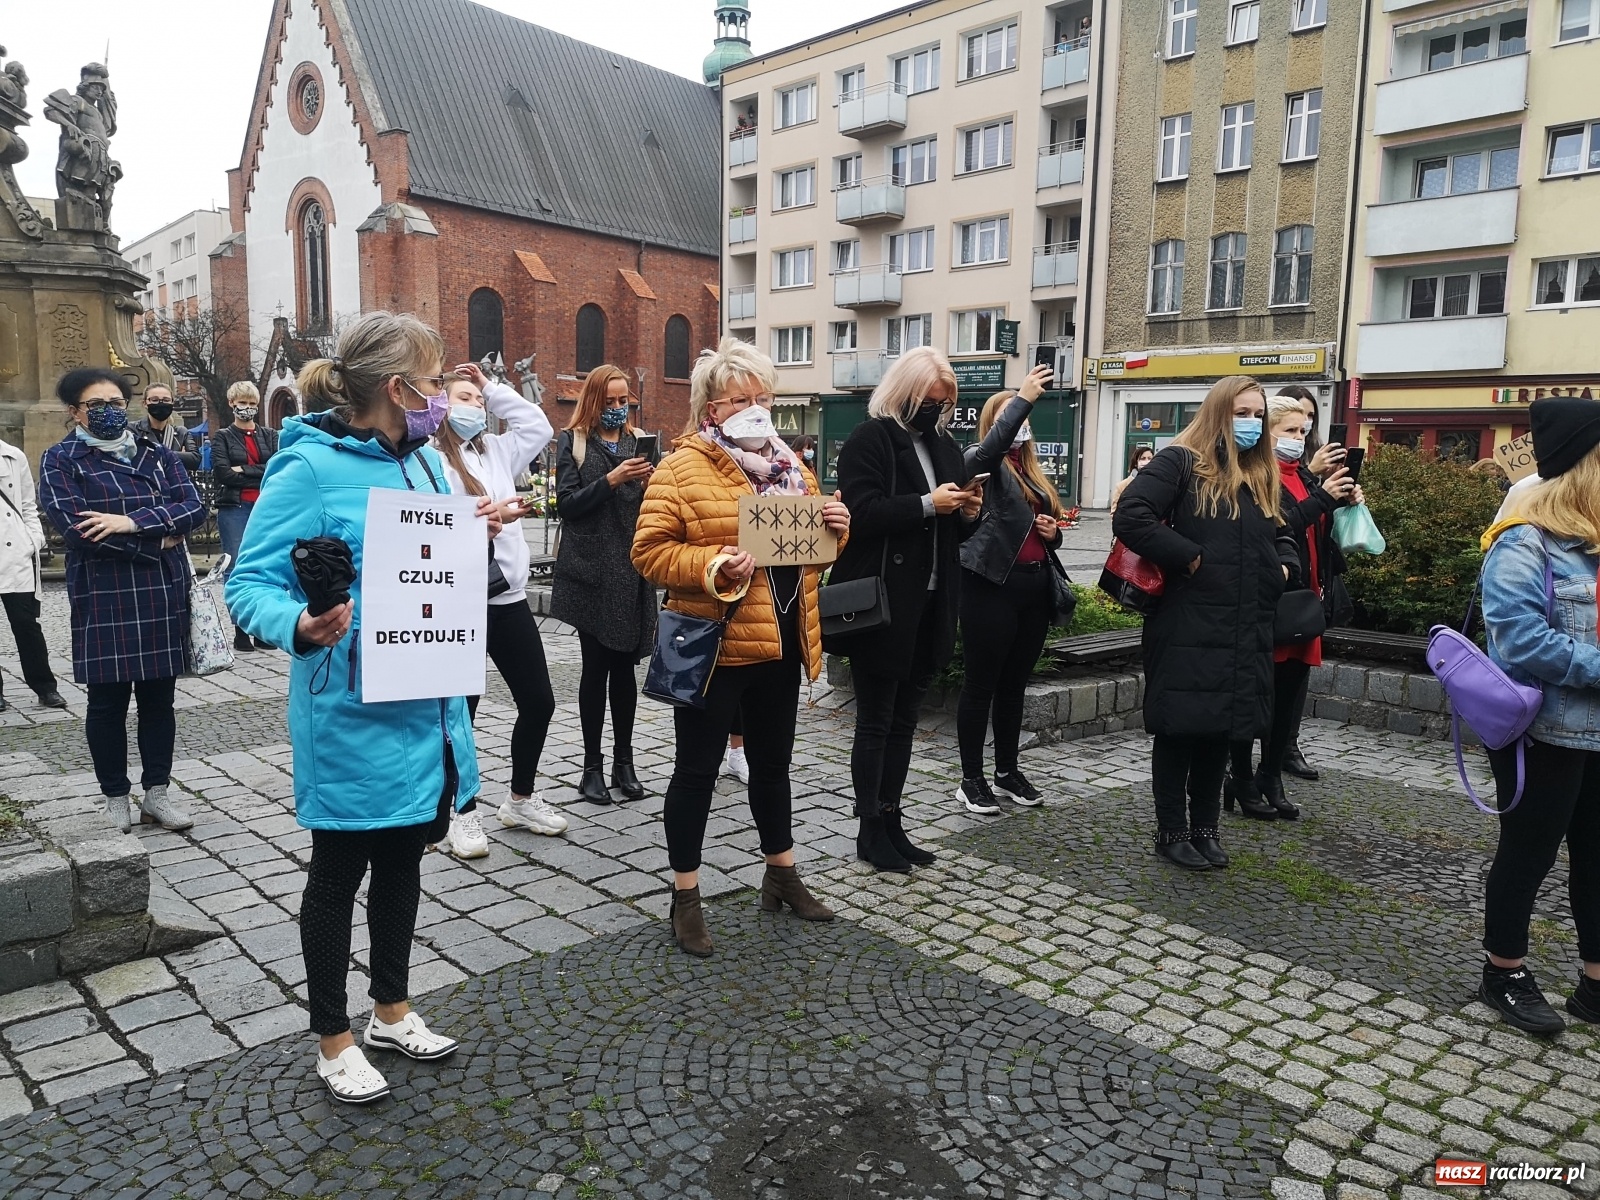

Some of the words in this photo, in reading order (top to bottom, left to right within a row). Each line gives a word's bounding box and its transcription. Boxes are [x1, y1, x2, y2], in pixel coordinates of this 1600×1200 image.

[1242, 356, 1278, 365] STEFCZYK
[1281, 355, 1314, 363] FINANSE
[400, 509, 454, 530] MYŚLĘ
[398, 570, 455, 588] CZUJĘ
[376, 629, 466, 645] DECYDUJĘ
[1509, 971, 1526, 980] FILA
